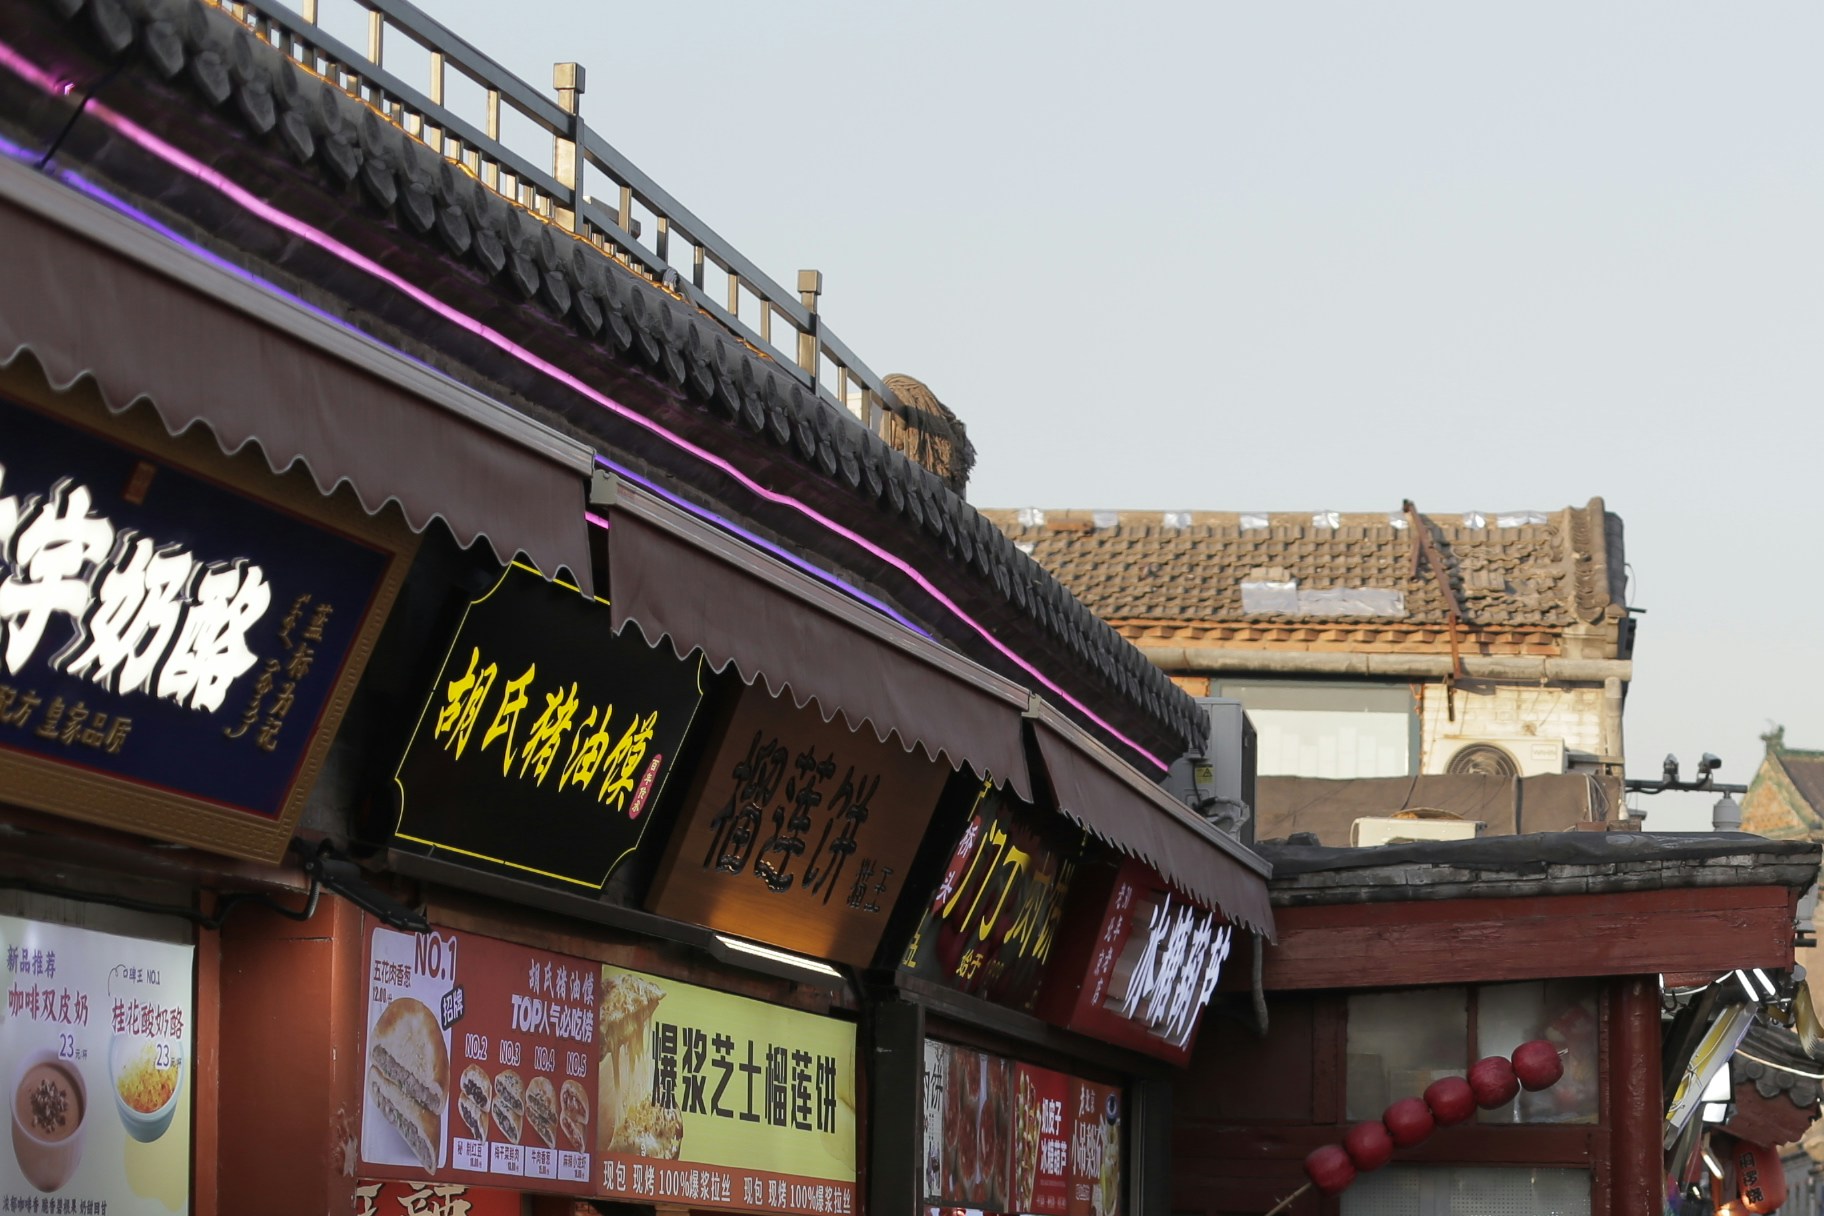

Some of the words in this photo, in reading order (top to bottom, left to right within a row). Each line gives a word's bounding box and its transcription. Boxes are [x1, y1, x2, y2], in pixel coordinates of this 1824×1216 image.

[0, 464, 272, 714] 宇奶酪
[704, 730, 883, 904] 榴莲饼
[6, 943, 57, 979] 新品推荐
[414, 932, 457, 981] NO.1
[8, 981, 89, 1028] 咖啡双皮奶
[112, 998, 184, 1041] 桂花酸奶酪
[443, 988, 464, 1025] 招牌
[464, 1033, 488, 1061] NO.2
[499, 1039, 521, 1067] NO.3
[534, 1045, 555, 1072] NO.4
[566, 1051, 588, 1078] NO.5
[651, 1020, 837, 1134] 爆浆芝士榴莲饼
[603, 1159, 626, 1191] 现包
[632, 1164, 655, 1196] 现烤
[658, 1169, 731, 1202] 100%爆浆拉丝
[743, 1176, 763, 1206] 现包
[768, 1179, 787, 1209] 现烤
[790, 1184, 851, 1214] 100%爆浆拉丝
